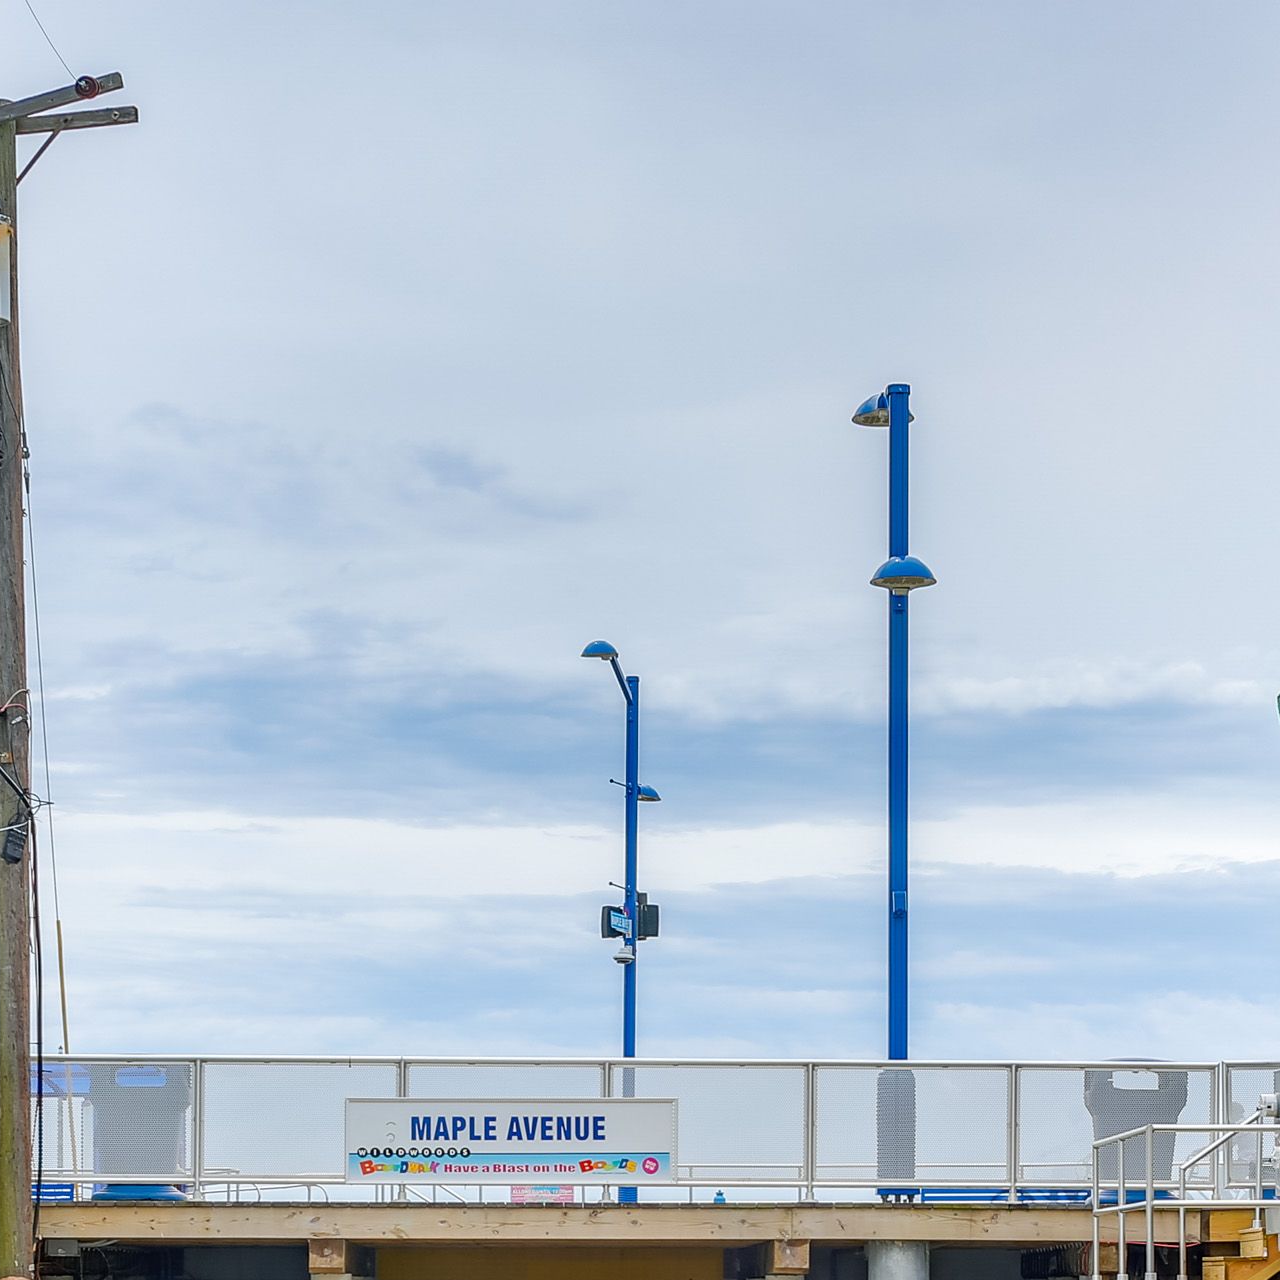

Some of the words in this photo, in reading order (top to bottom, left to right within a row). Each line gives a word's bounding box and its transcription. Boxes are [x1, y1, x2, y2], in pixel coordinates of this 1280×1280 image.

[410, 1116, 497, 1141] MAPLE
[506, 1116, 606, 1141] AVENUE
[357, 1147, 470, 1158] WILDWOODS
[444, 1164, 479, 1173] Have
[482, 1165, 490, 1173] a
[493, 1164, 529, 1173] Blast
[533, 1165, 550, 1173] on
[554, 1164, 576, 1173] the
